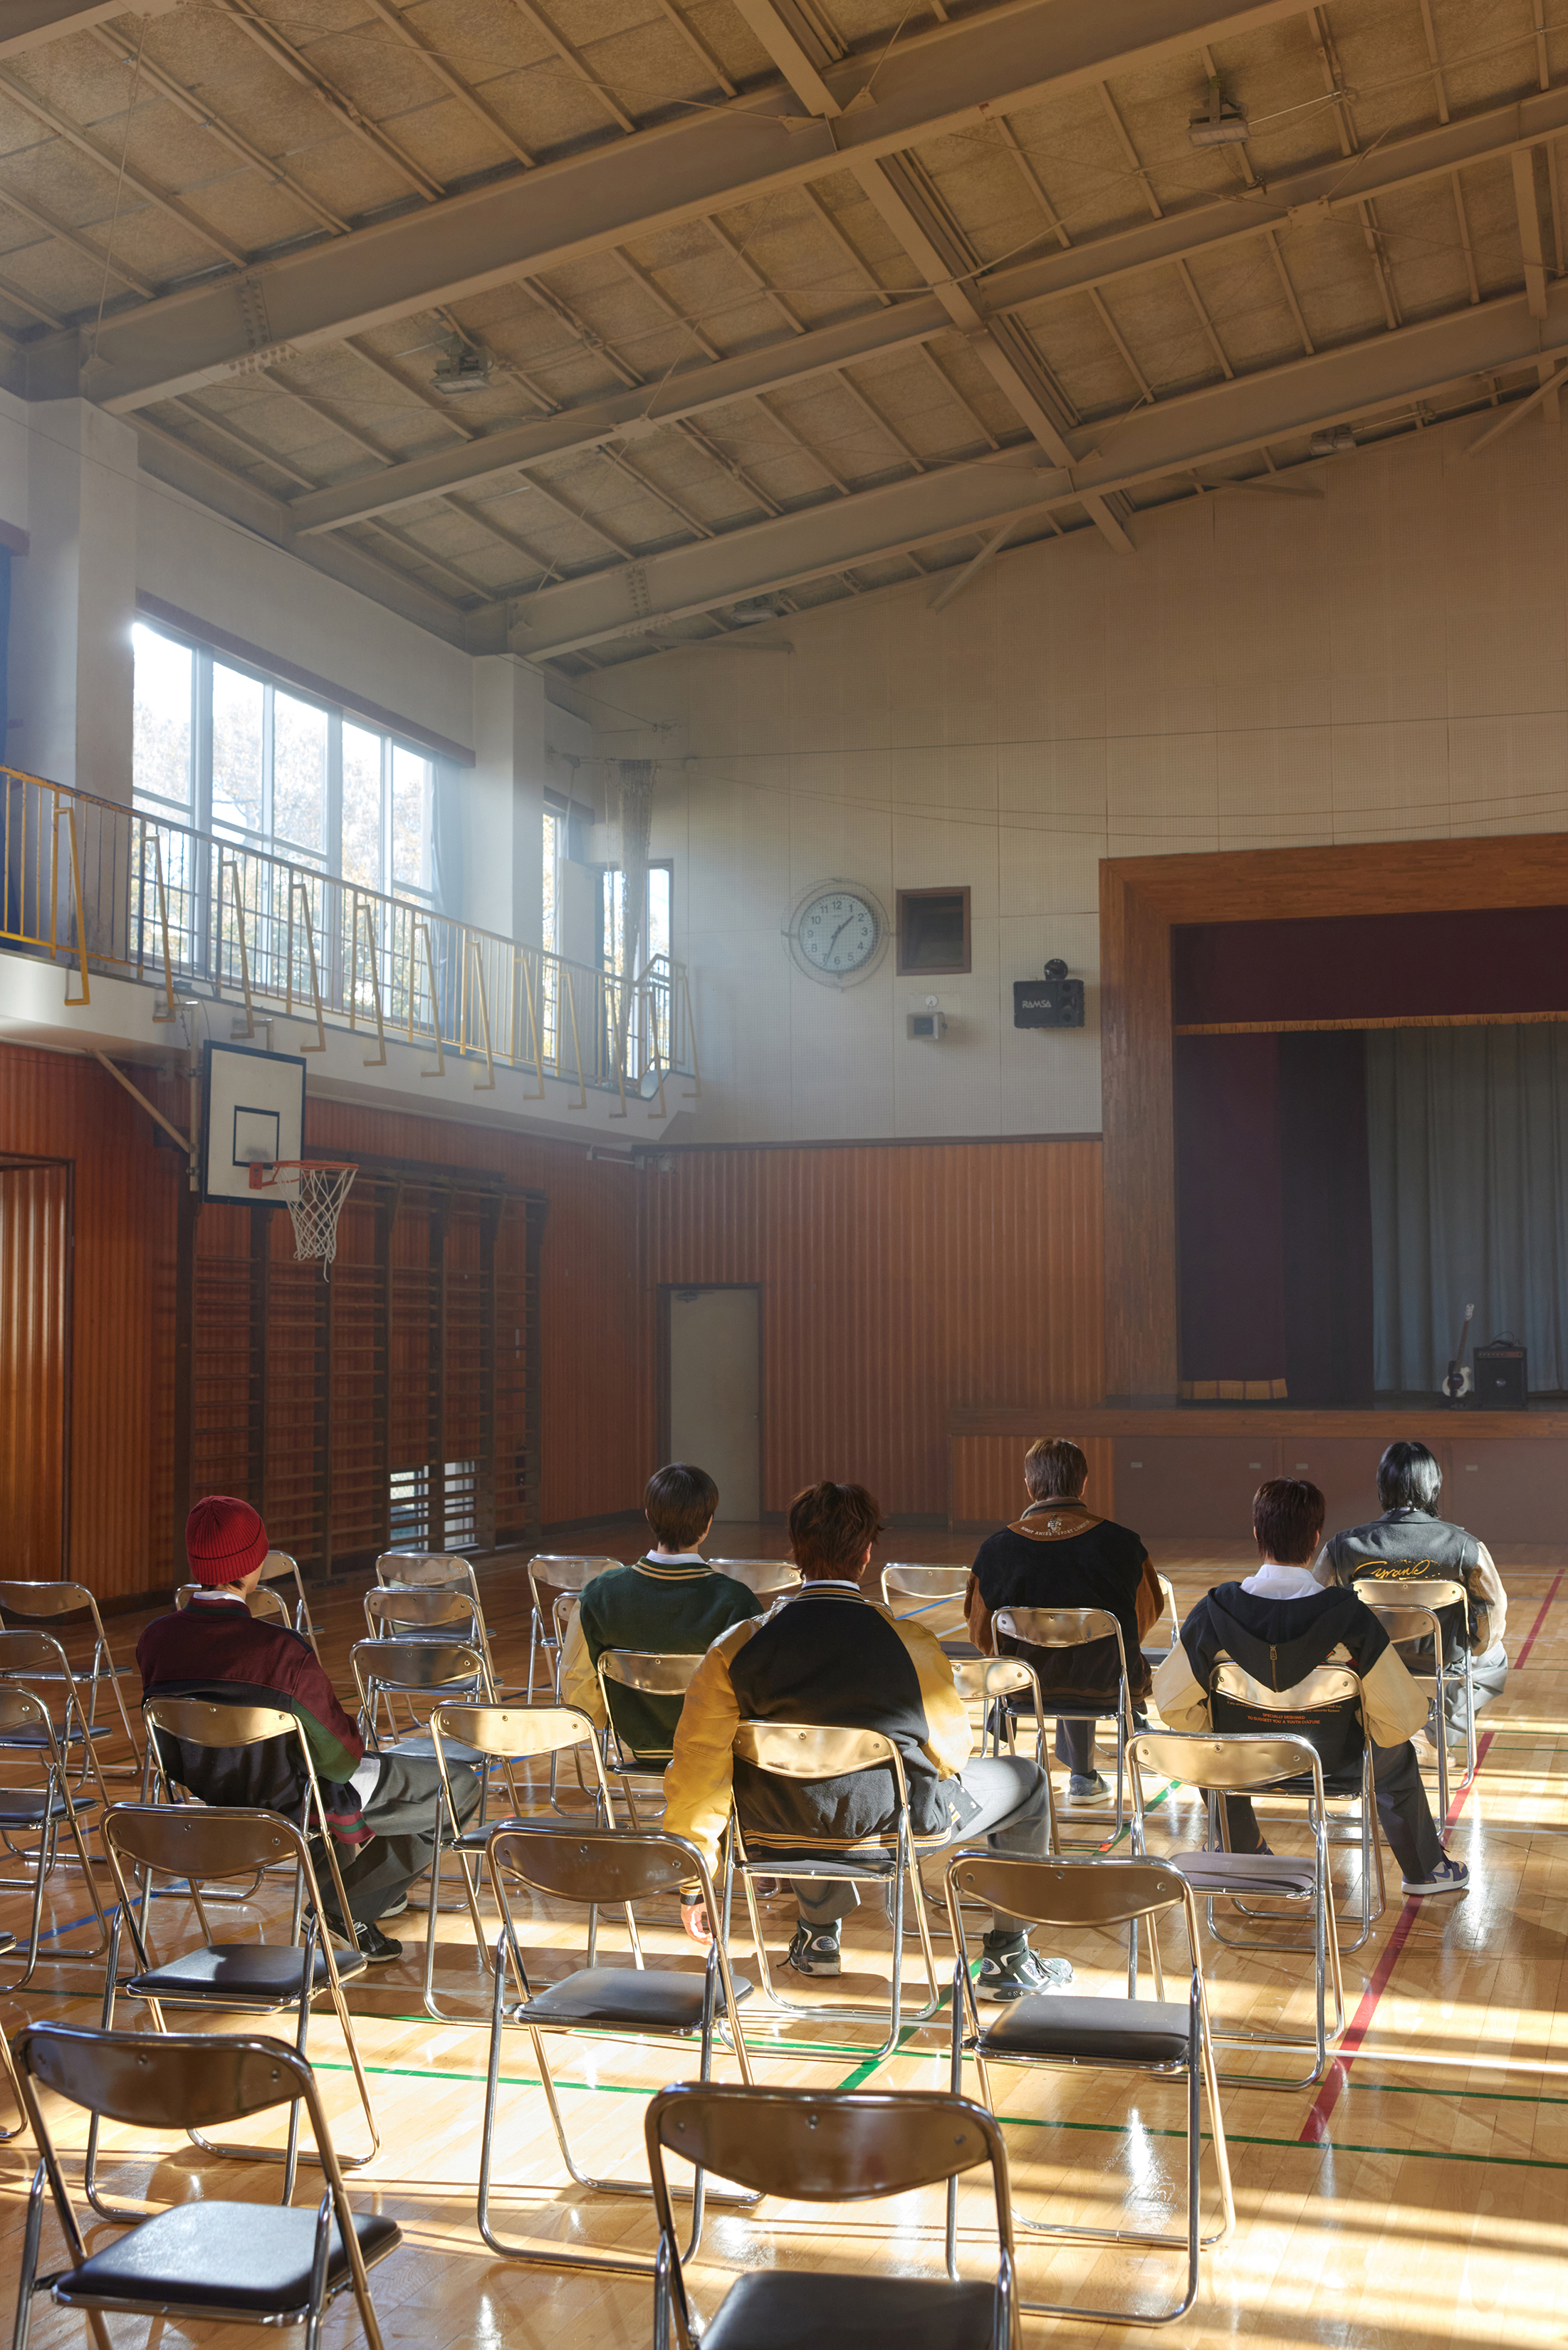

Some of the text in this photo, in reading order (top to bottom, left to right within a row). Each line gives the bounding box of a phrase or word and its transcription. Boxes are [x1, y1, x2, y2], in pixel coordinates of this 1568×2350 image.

[820, 905, 828, 914] 11
[832, 901, 842, 910] 12
[812, 916, 821, 924] 10
[858, 913, 864, 921] 2
[807, 930, 814, 939] 9
[862, 927, 868, 936] 3
[811, 944, 817, 952] 8
[857, 941, 864, 951] 4
[822, 954, 828, 962] 7
[834, 956, 840, 965] 6
[847, 952, 854, 961] 5
[1022, 999, 1052, 1008] RAMSA
